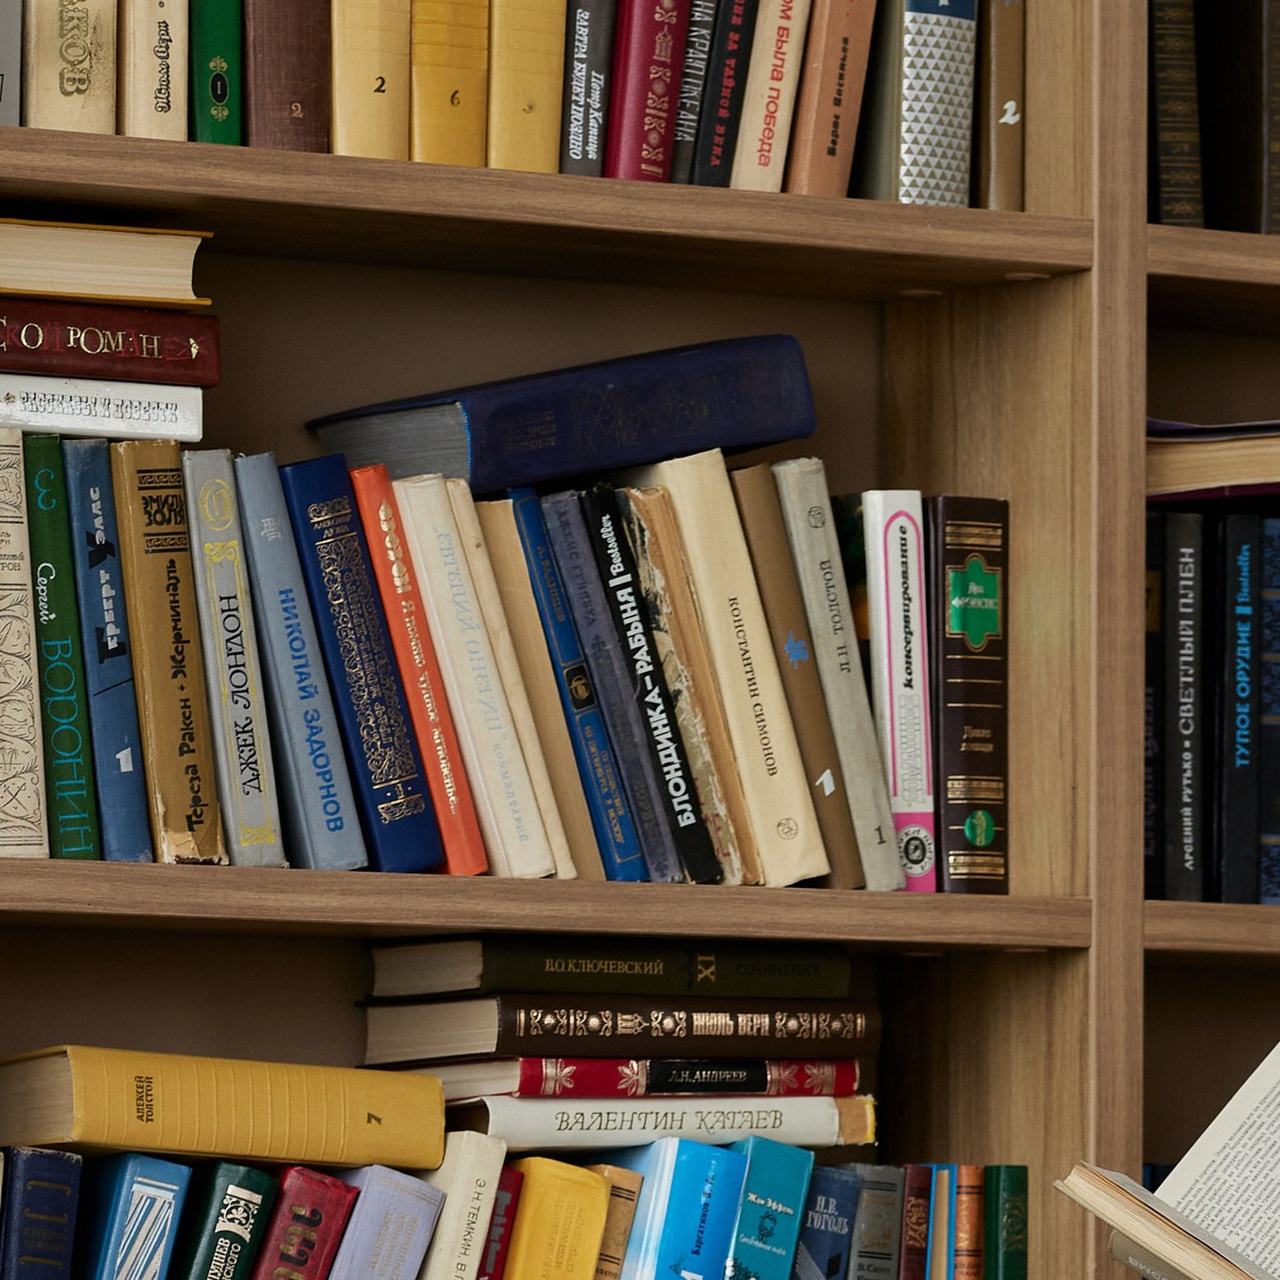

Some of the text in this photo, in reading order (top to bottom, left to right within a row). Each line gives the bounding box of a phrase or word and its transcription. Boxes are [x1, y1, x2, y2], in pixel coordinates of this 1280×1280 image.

[373, 76, 387, 94] 2
[450, 90, 461, 107] 6
[568, 8, 590, 160] ЗАВТРА БУДЕТ ПОЗДНО
[768, 25, 791, 82] БЫЛА
[585, 70, 604, 161] Петр Капица
[709, 57, 738, 166] ТАЙНОЙ ВЕКА
[999, 100, 1021, 126] 2
[596, 512, 626, 576] Bestseller
[818, 557, 845, 635] ТОЛСТОЙ
[896, 524, 916, 689] консервирование
[28, 561, 93, 855] Сергей ВОРОНИН
[163, 556, 210, 832] Тереза Ракен Жерминаль
[219, 592, 263, 795] ДЖЕК ЛОНДОН
[275, 585, 346, 834] НИКОЛАЙ ЗАДОРНОВ
[616, 584, 697, 828] БЛОНДИНКА-РАБЫНЯ
[726, 595, 780, 778] КОНСТАНТИН СИМОНОВ
[1177, 546, 1196, 871] АРСЕНИЙ РУТЬКО СВЕТЛЫЙ ПЛЕН
[1233, 620, 1252, 767] ТУПОЕ ОРУДИЕ
[134, 1074, 145, 1121] АЛЕКСЕЙ
[144, 1075, 155, 1123] ТОЛСТОЙ
[554, 1109, 783, 1135] ВАЛЕНТИН КАТАЕВ
[804, 1209, 850, 1235] ГОГОЛЬ
[815, 1194, 839, 1214] Н.В.
